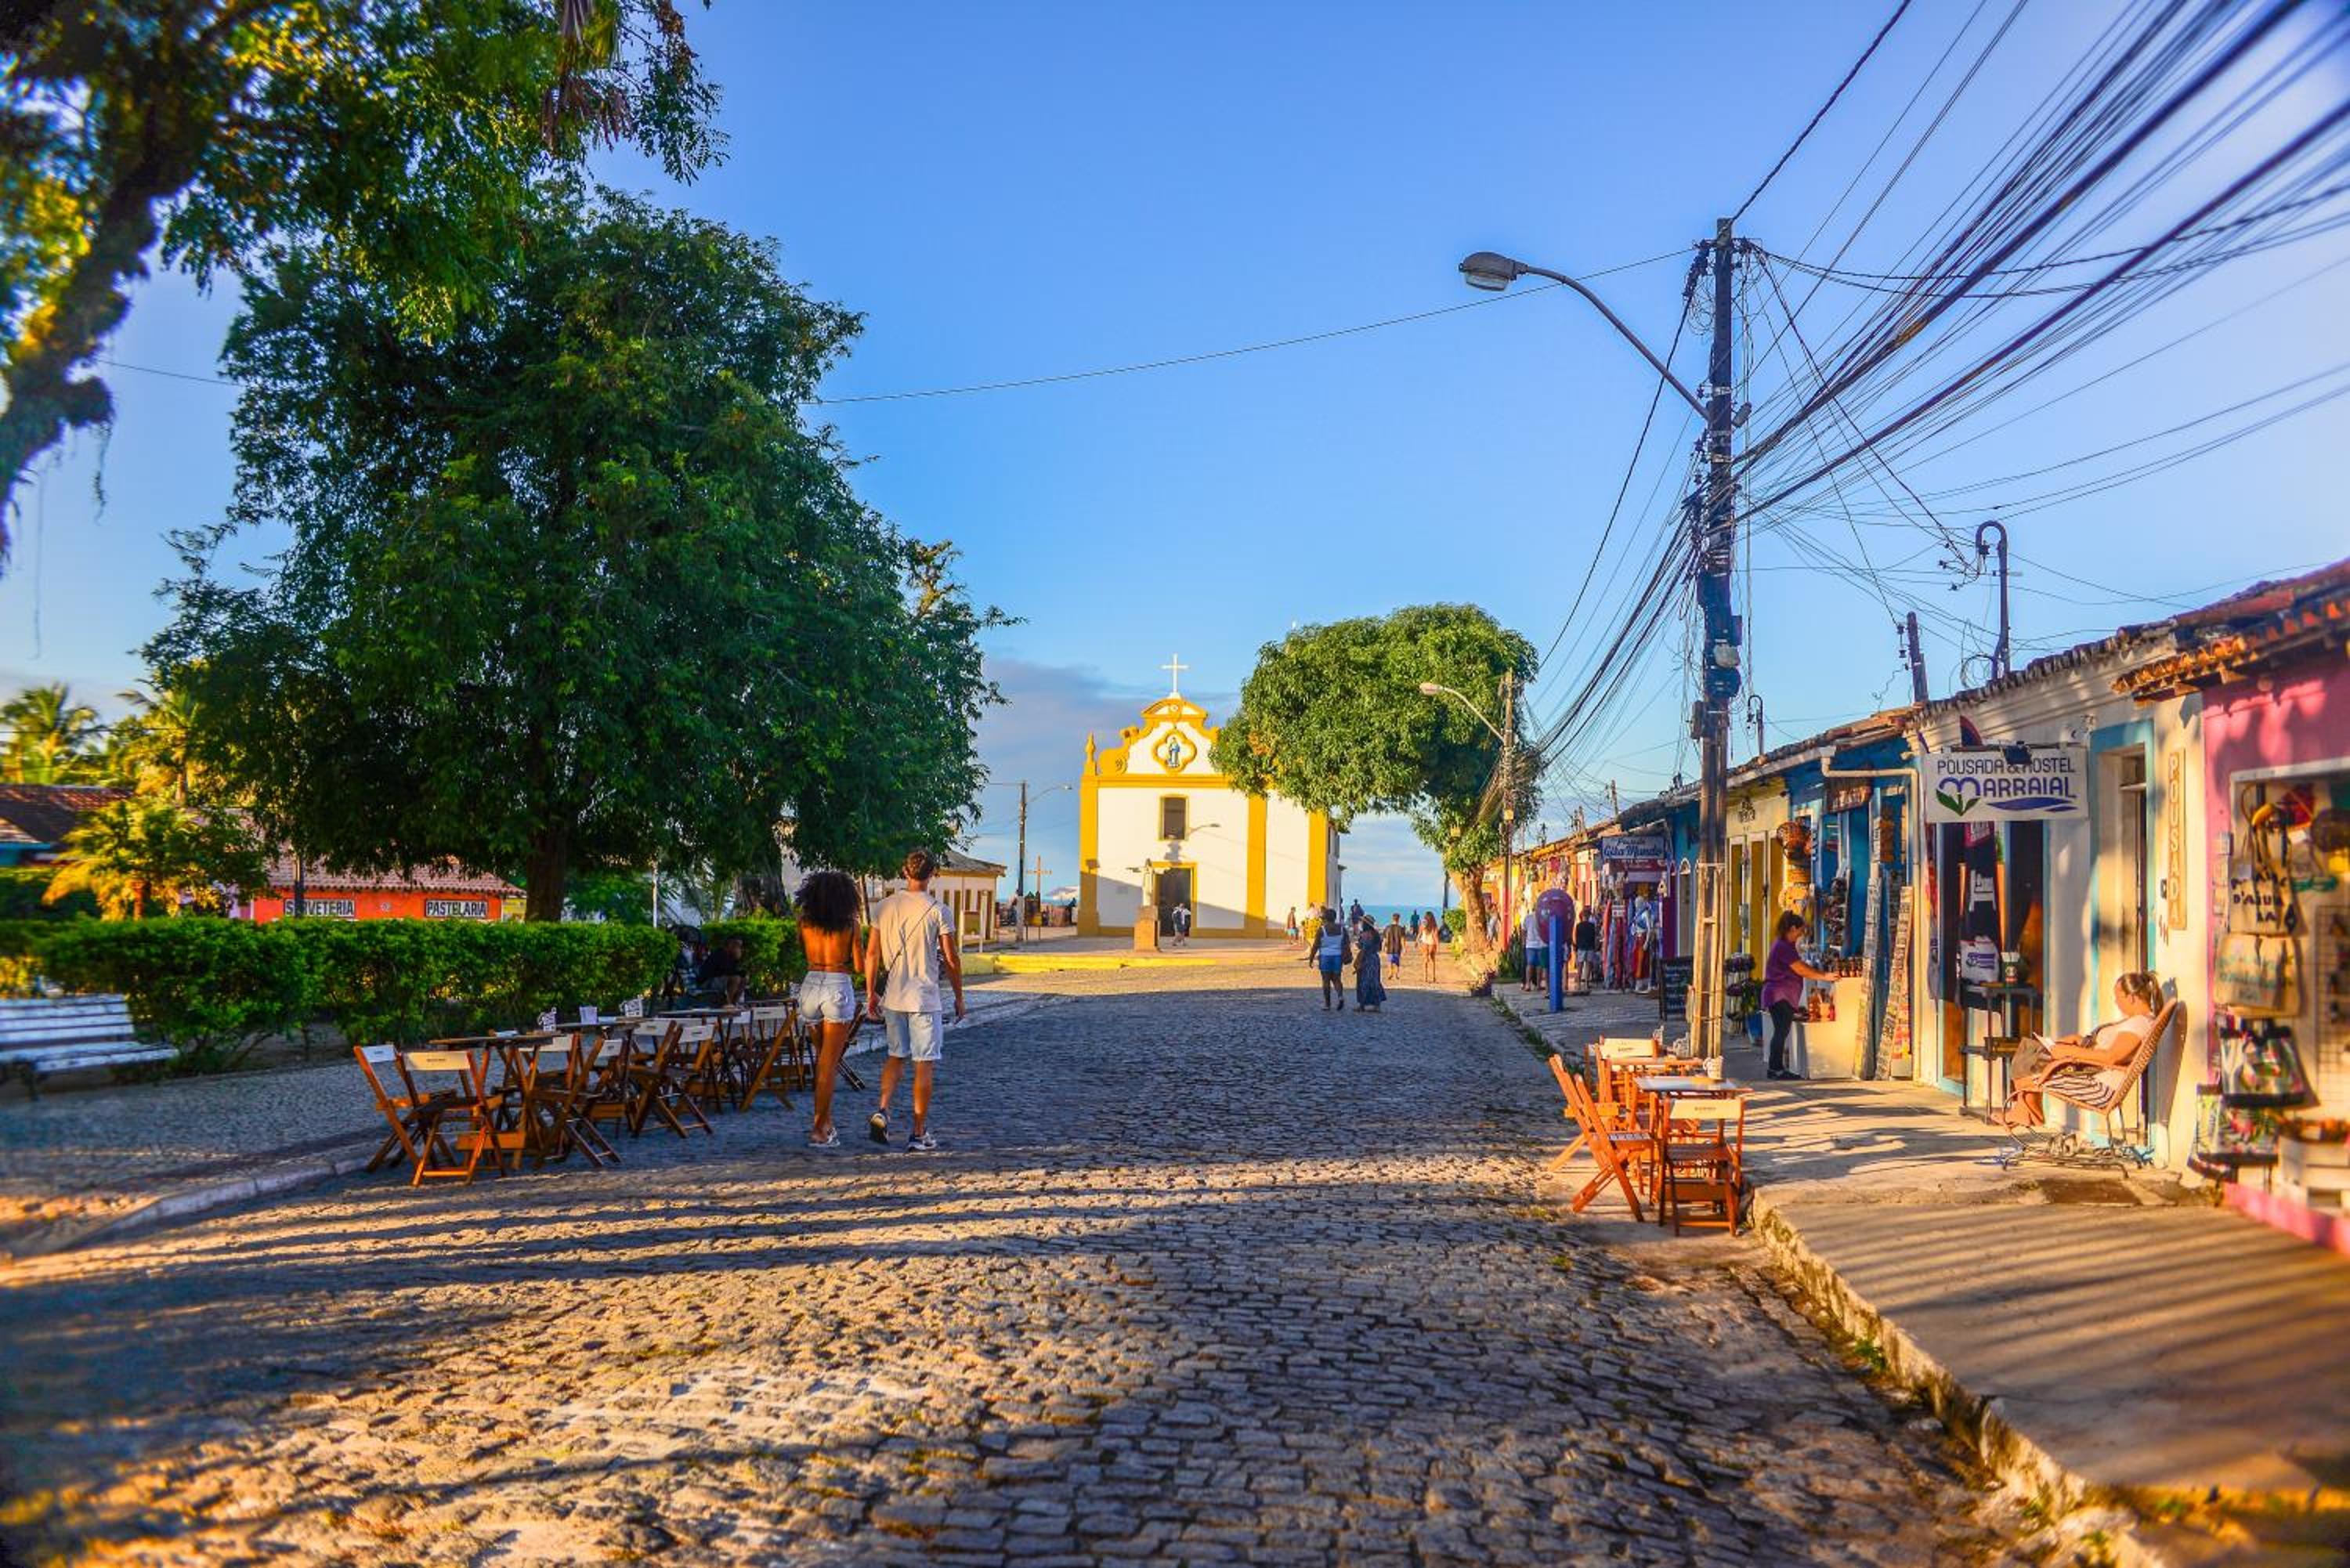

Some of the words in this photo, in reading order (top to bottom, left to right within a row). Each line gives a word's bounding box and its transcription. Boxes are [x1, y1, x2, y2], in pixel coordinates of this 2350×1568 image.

[1937, 759, 2003, 775] POUSADA
[1938, 776, 2077, 798] MARRAIAL
[2168, 753, 2180, 926] POUSADA
[427, 901, 486, 916] PASTELARIA
